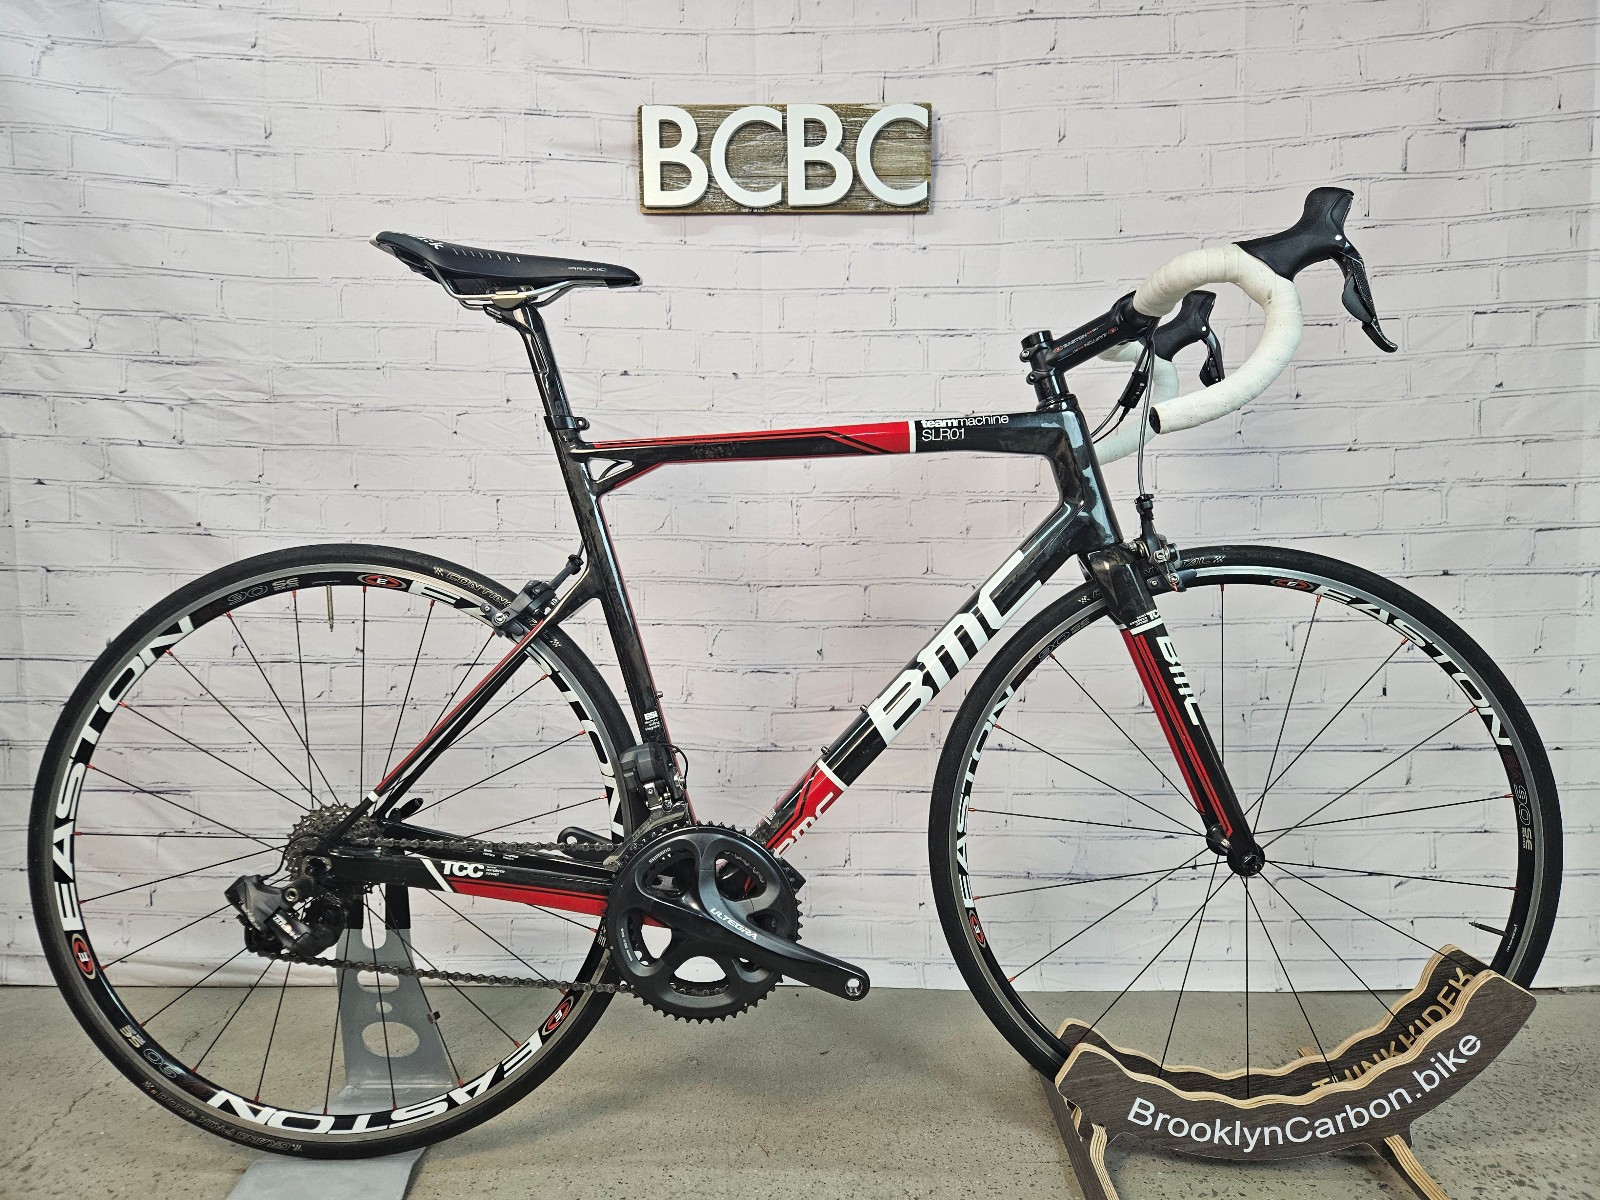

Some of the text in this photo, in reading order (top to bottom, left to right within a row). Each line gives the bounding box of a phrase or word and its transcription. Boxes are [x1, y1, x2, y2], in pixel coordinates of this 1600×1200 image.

[642, 103, 928, 208] BCBC
[921, 415, 1009, 428] teammachine
[921, 428, 966, 441] SLR01
[1312, 584, 1513, 746] EASTON
[53, 615, 194, 931] EASTON
[956, 683, 1014, 909] EASTON
[440, 860, 485, 878] TCC
[710, 907, 758, 941] ULTEGRA
[206, 1029, 543, 1135] EASTON
[1127, 1034, 1482, 1153] BrooklynCarbon.bike
